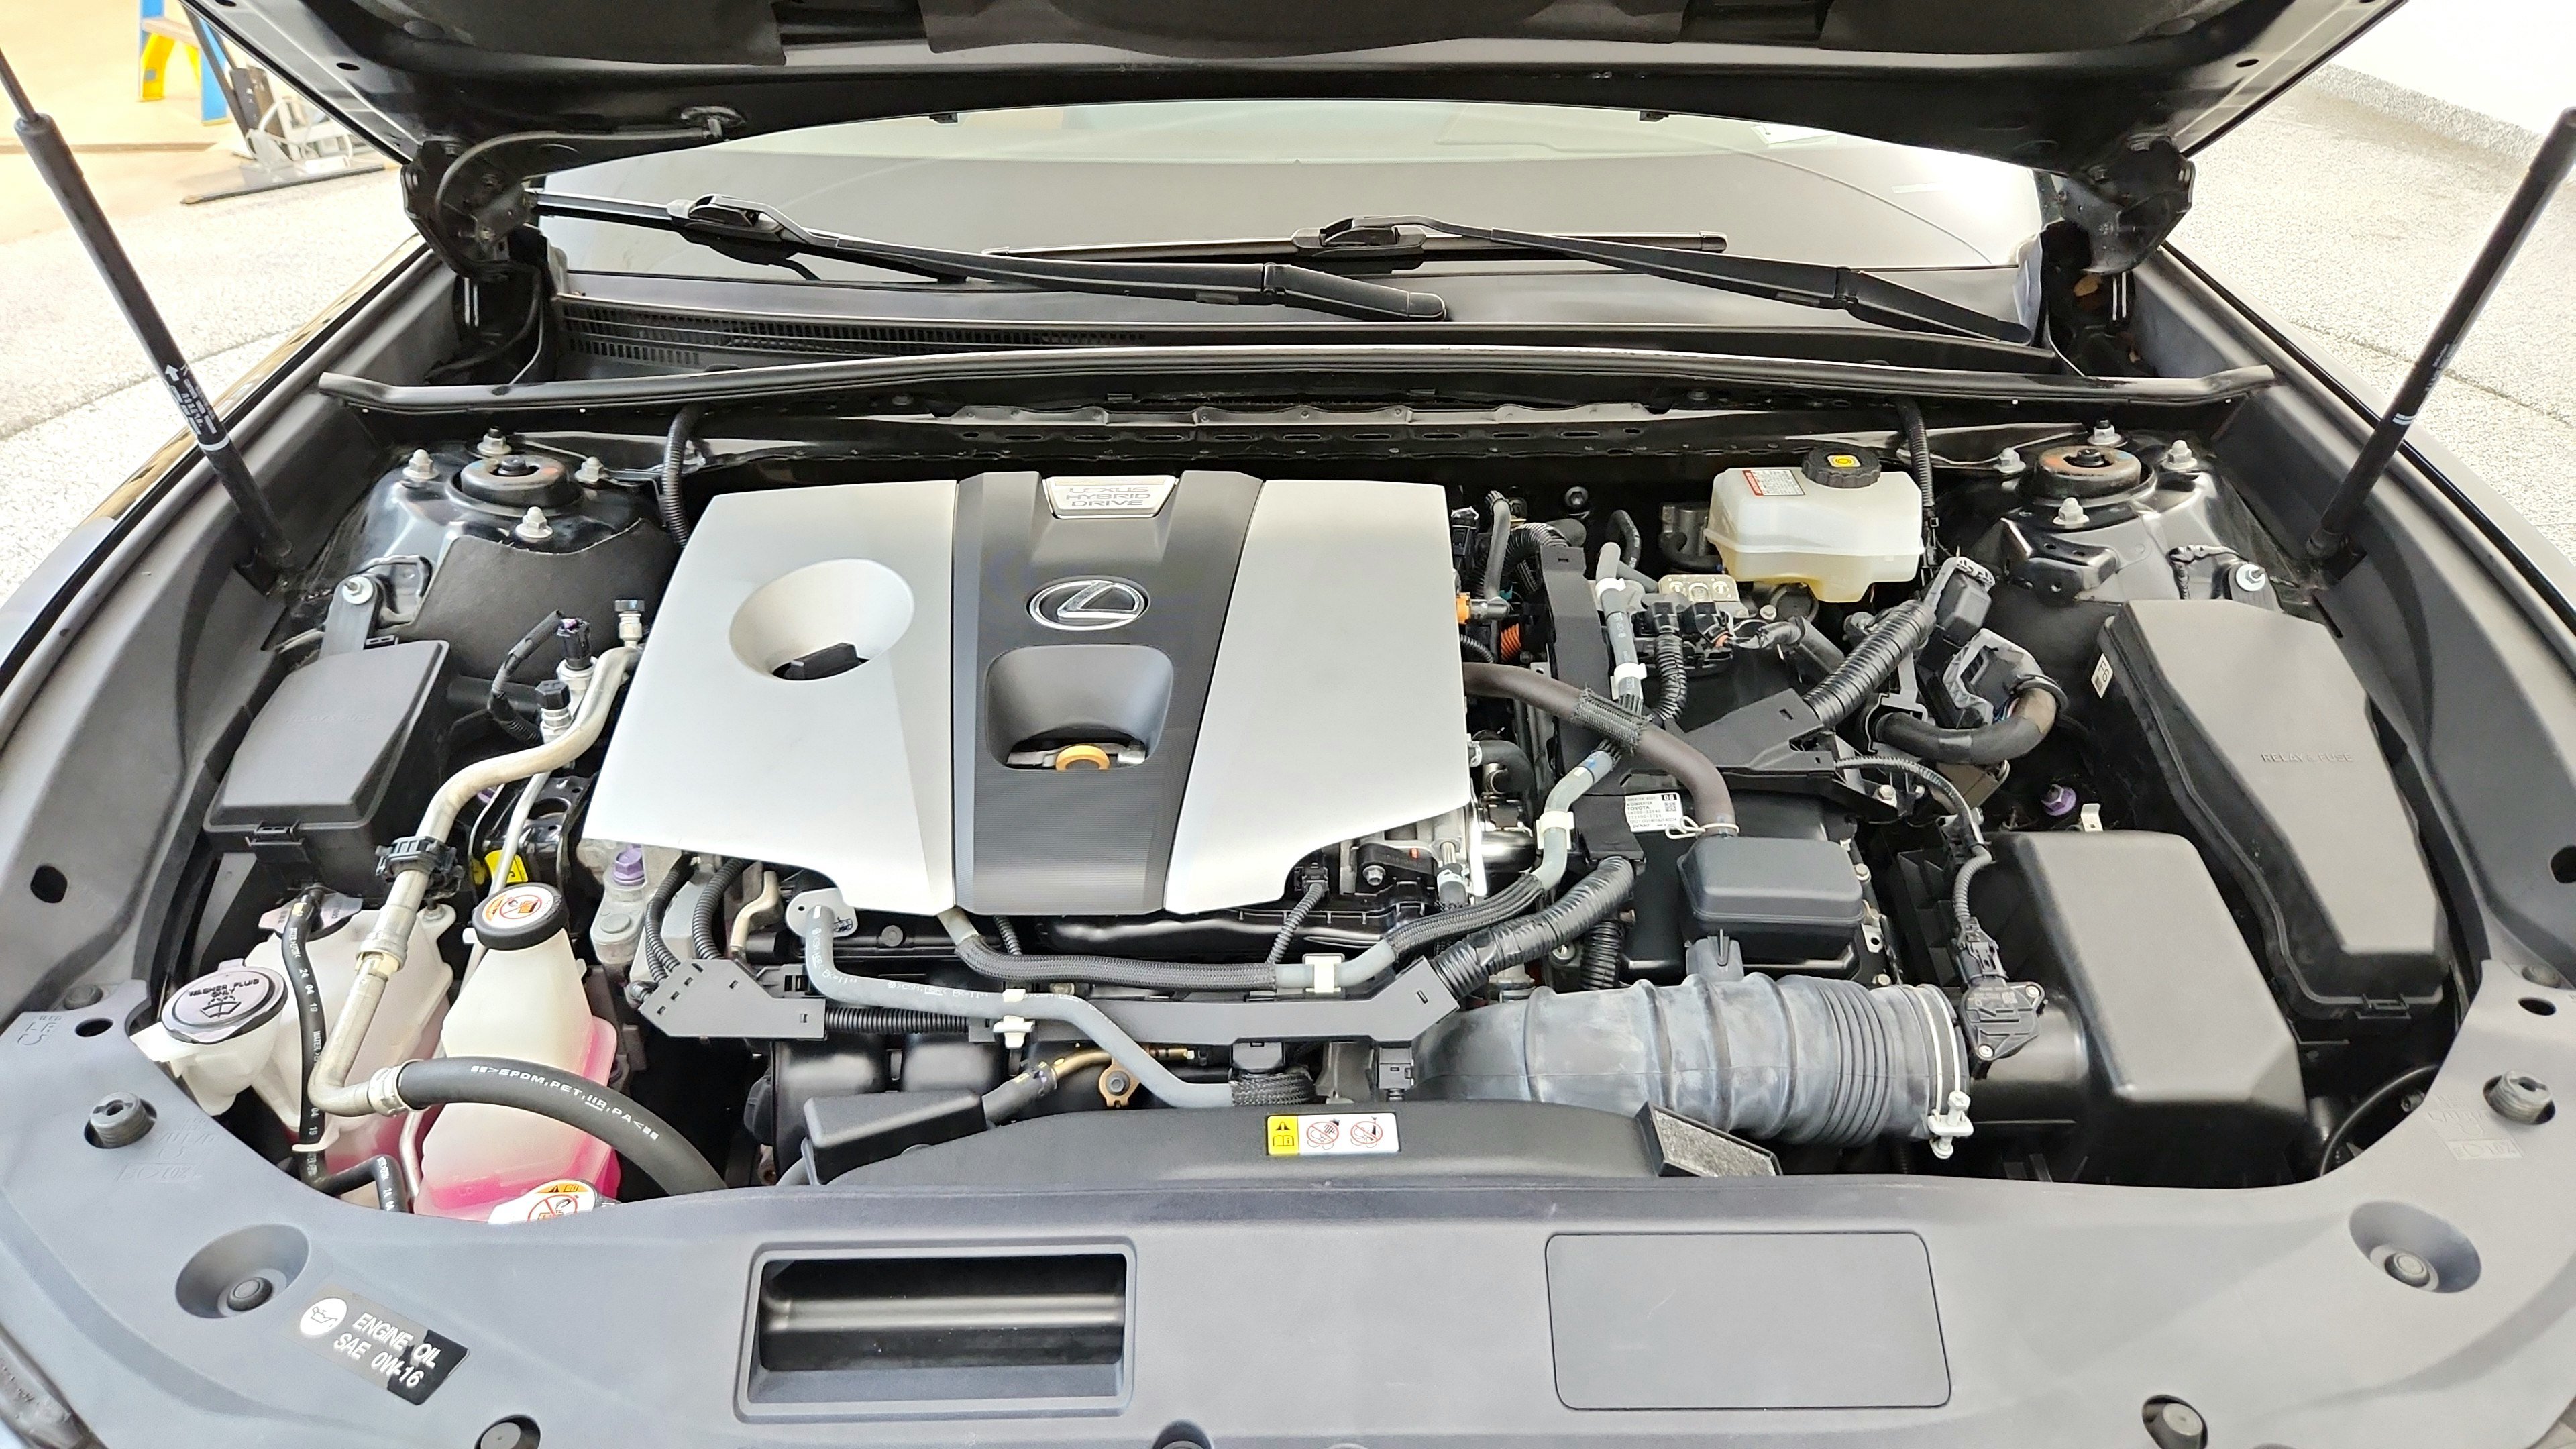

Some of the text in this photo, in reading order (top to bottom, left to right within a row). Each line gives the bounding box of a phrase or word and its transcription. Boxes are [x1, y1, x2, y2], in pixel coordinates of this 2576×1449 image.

[2098, 660, 2110, 682] F6
[2261, 753, 2303, 763] RELAY
[2318, 753, 2353, 763] FUSE
[189, 979, 260, 997] WASHER FLUID
[211, 988, 235, 998] ONLY
[299, 968, 318, 1012] 24 04 19
[352, 1312, 441, 1369] ENGINE OIL
[333, 1332, 425, 1389] SAE 0W-16
